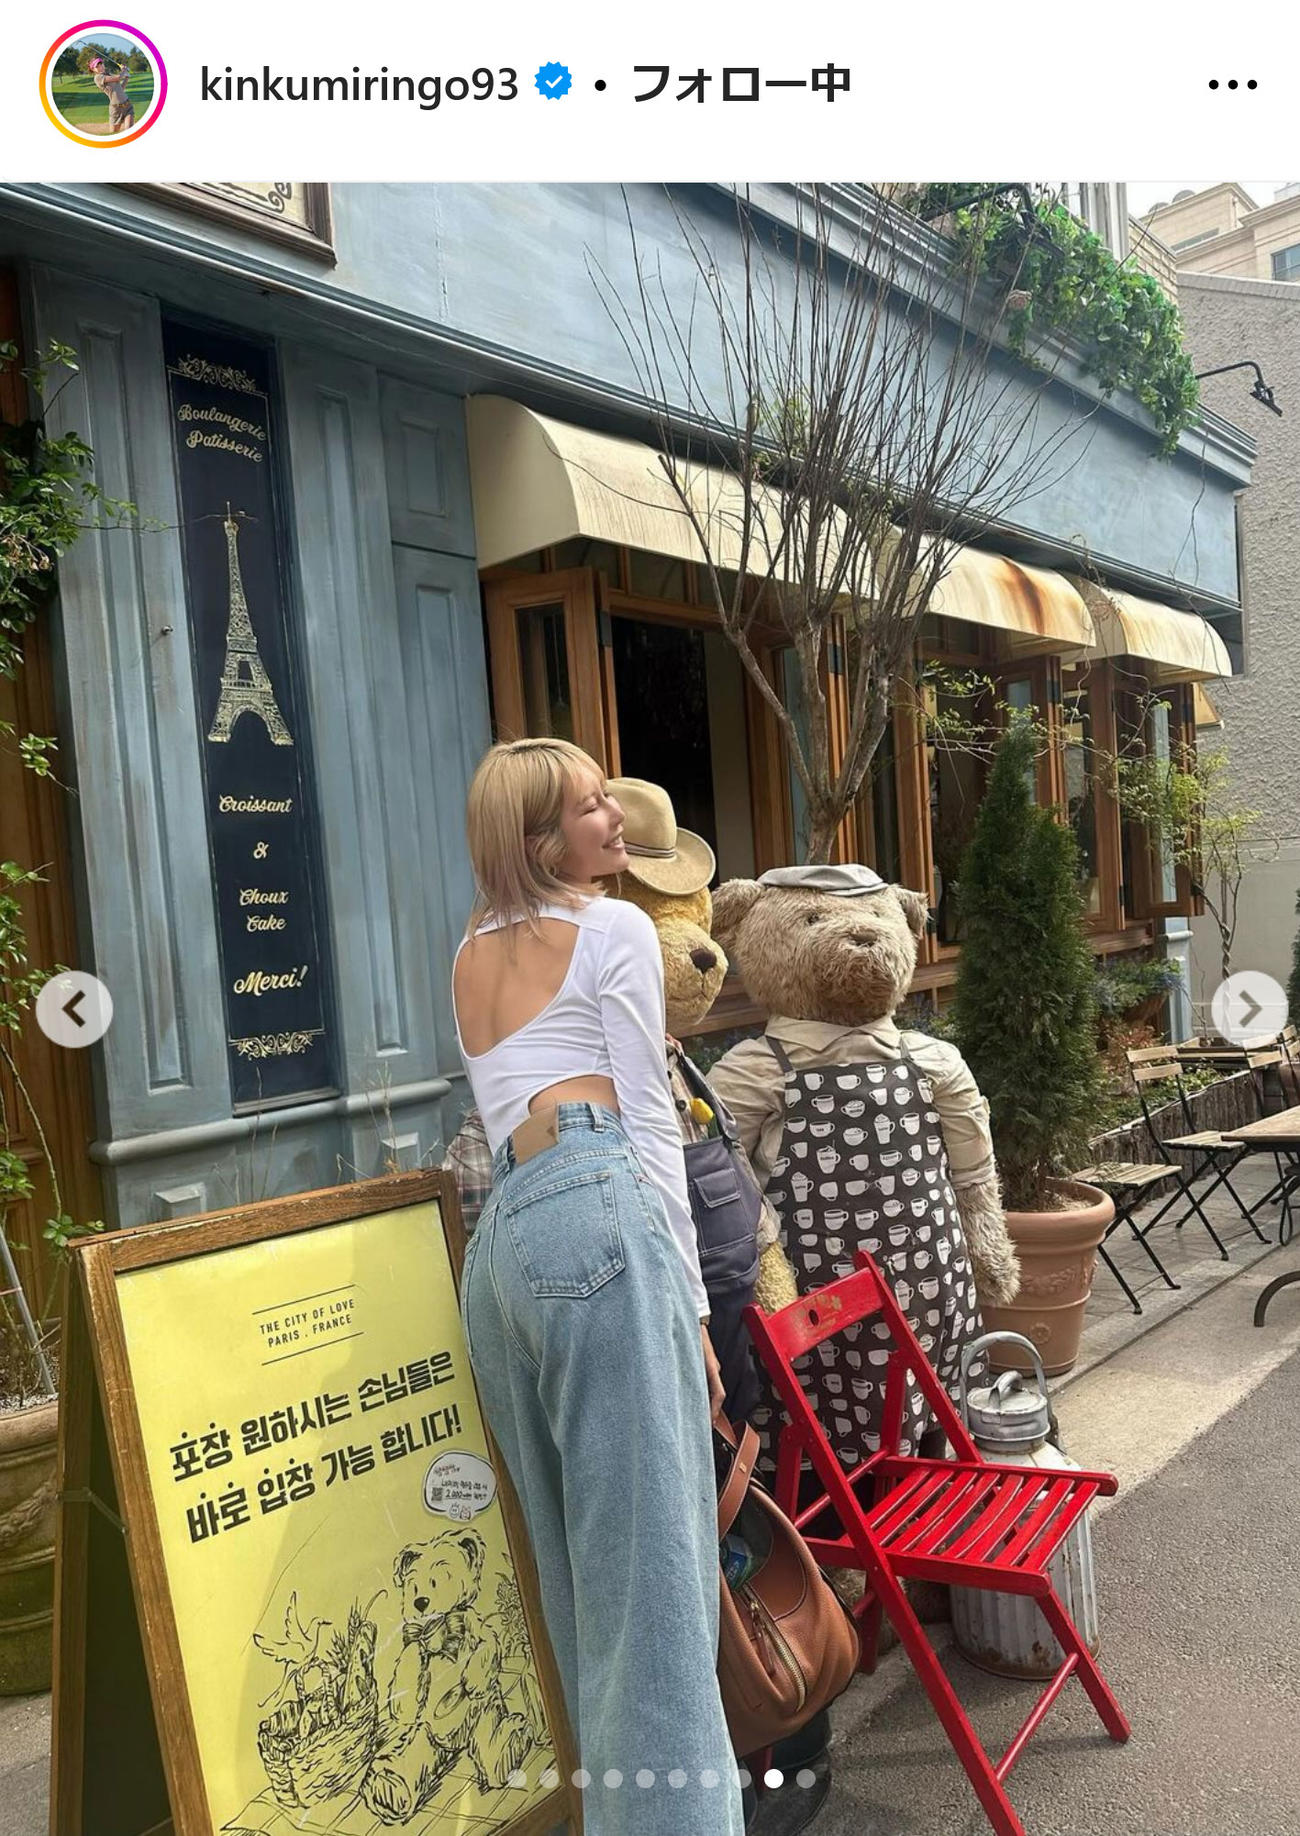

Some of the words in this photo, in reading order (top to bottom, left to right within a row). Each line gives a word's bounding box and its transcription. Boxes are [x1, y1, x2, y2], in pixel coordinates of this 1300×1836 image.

[177, 404, 266, 441] Boulangerie
[186, 430, 263, 462] Patisserie
[219, 795, 294, 813] Croissant
[253, 842, 269, 860] &
[239, 888, 289, 906] Choux
[246, 914, 287, 932] Cake
[233, 965, 308, 996] Merci!
[260, 1320, 280, 1335] THE
[284, 1312, 308, 1328] CITY
[312, 1307, 325, 1320] OF
[329, 1299, 355, 1315] LOVE
[268, 1330, 300, 1348] PARIS
[312, 1314, 352, 1334] FRANCE
[170, 1422, 234, 1482] 포장
[240, 1393, 353, 1456] 원하시는
[357, 1351, 456, 1413] 손님들은
[186, 1481, 251, 1543] 바로
[257, 1458, 316, 1515] 입장
[321, 1444, 376, 1487] 가능
[380, 1403, 463, 1463] 합니다!
